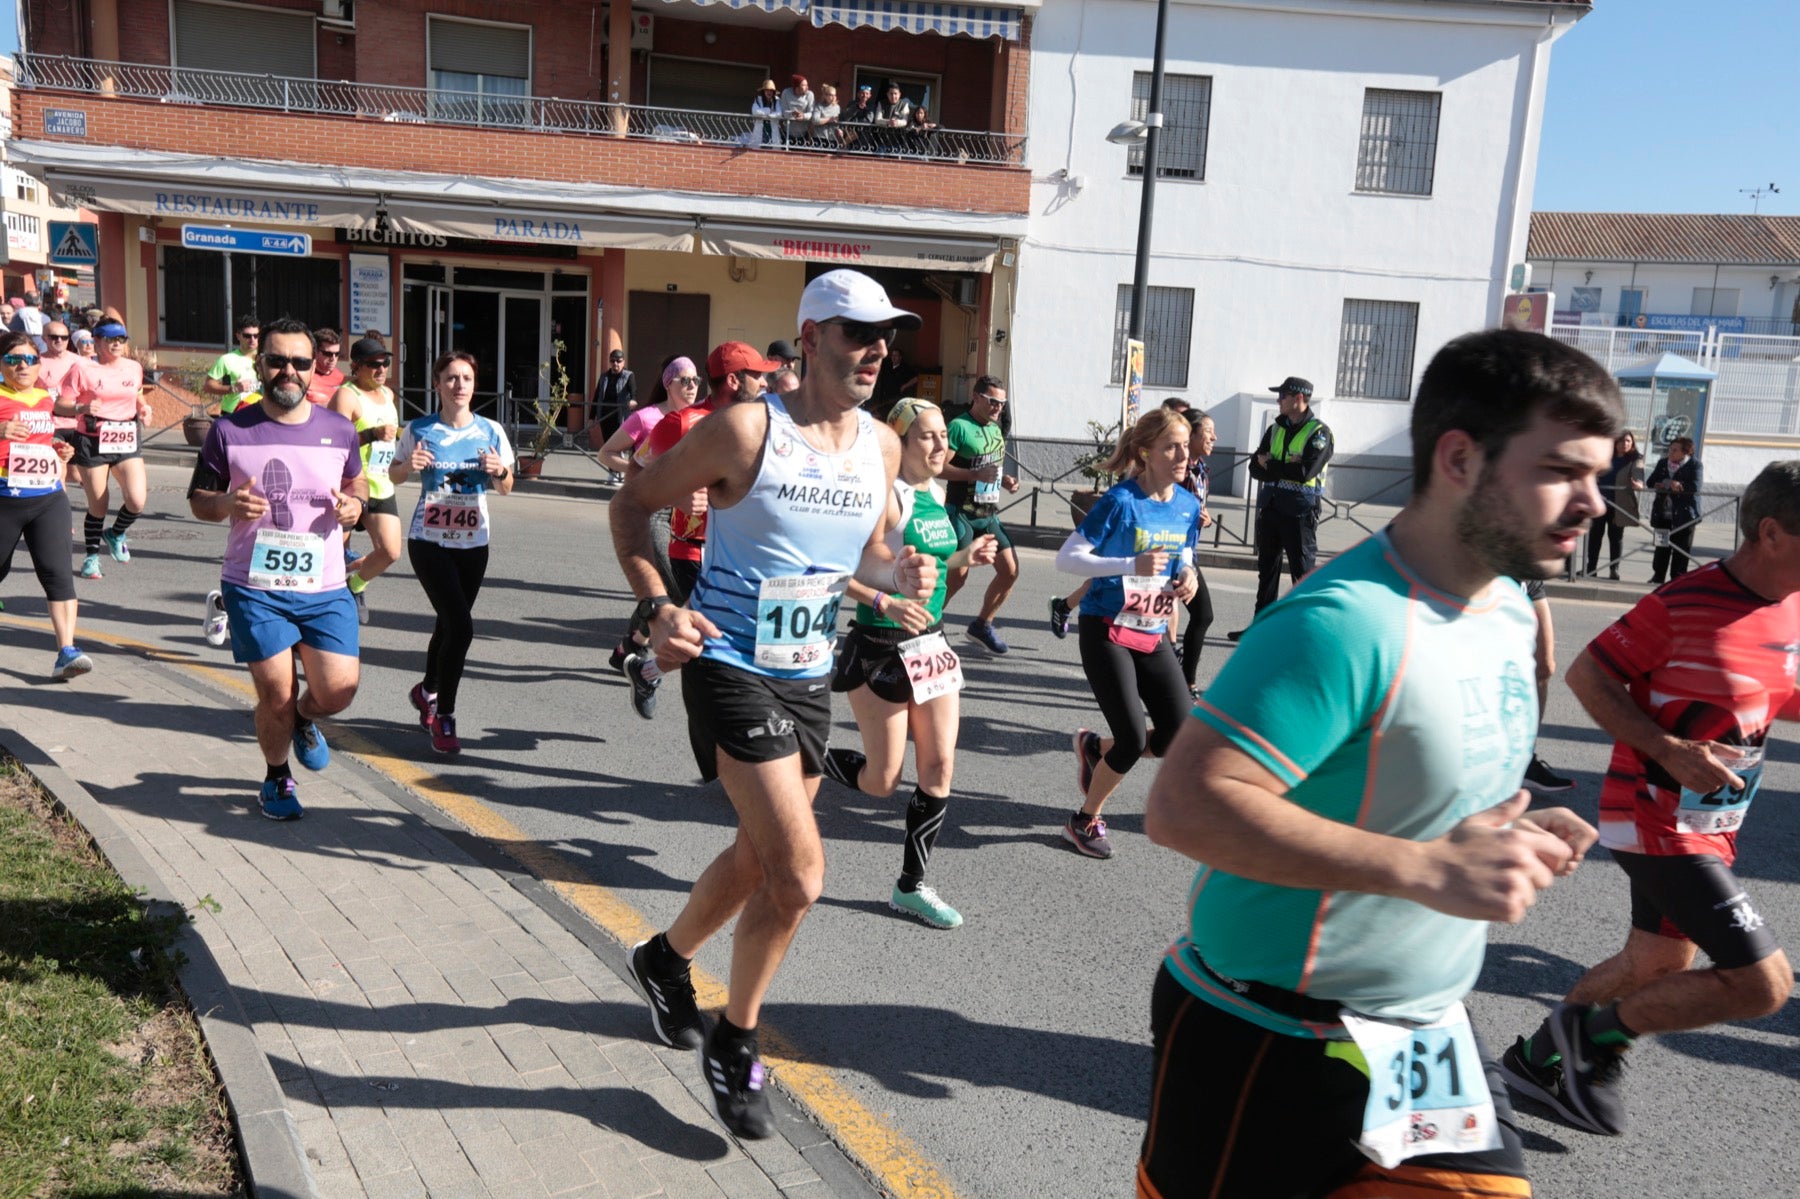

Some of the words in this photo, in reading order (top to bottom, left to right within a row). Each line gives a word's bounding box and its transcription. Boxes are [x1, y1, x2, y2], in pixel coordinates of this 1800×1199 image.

[54, 111, 84, 119] AVENIDA
[57, 118, 82, 127] JACOBO
[47, 125, 85, 135] CAMARERO
[155, 193, 319, 222] RESTAURANTE
[346, 227, 448, 247] BICHITOS
[494, 218, 583, 240] PARADA
[186, 231, 236, 245] Granada
[1651, 316, 1686, 327] ESCUELAS
[102, 431, 135, 443] 2295
[13, 457, 57, 474] 2291
[777, 484, 872, 509] MARACENA
[427, 507, 478, 527] 2146
[789, 505, 810, 513] CLUB
[823, 508, 863, 518] ATLETISMO
[264, 549, 313, 573] 593
[910, 651, 957, 683] 2108
